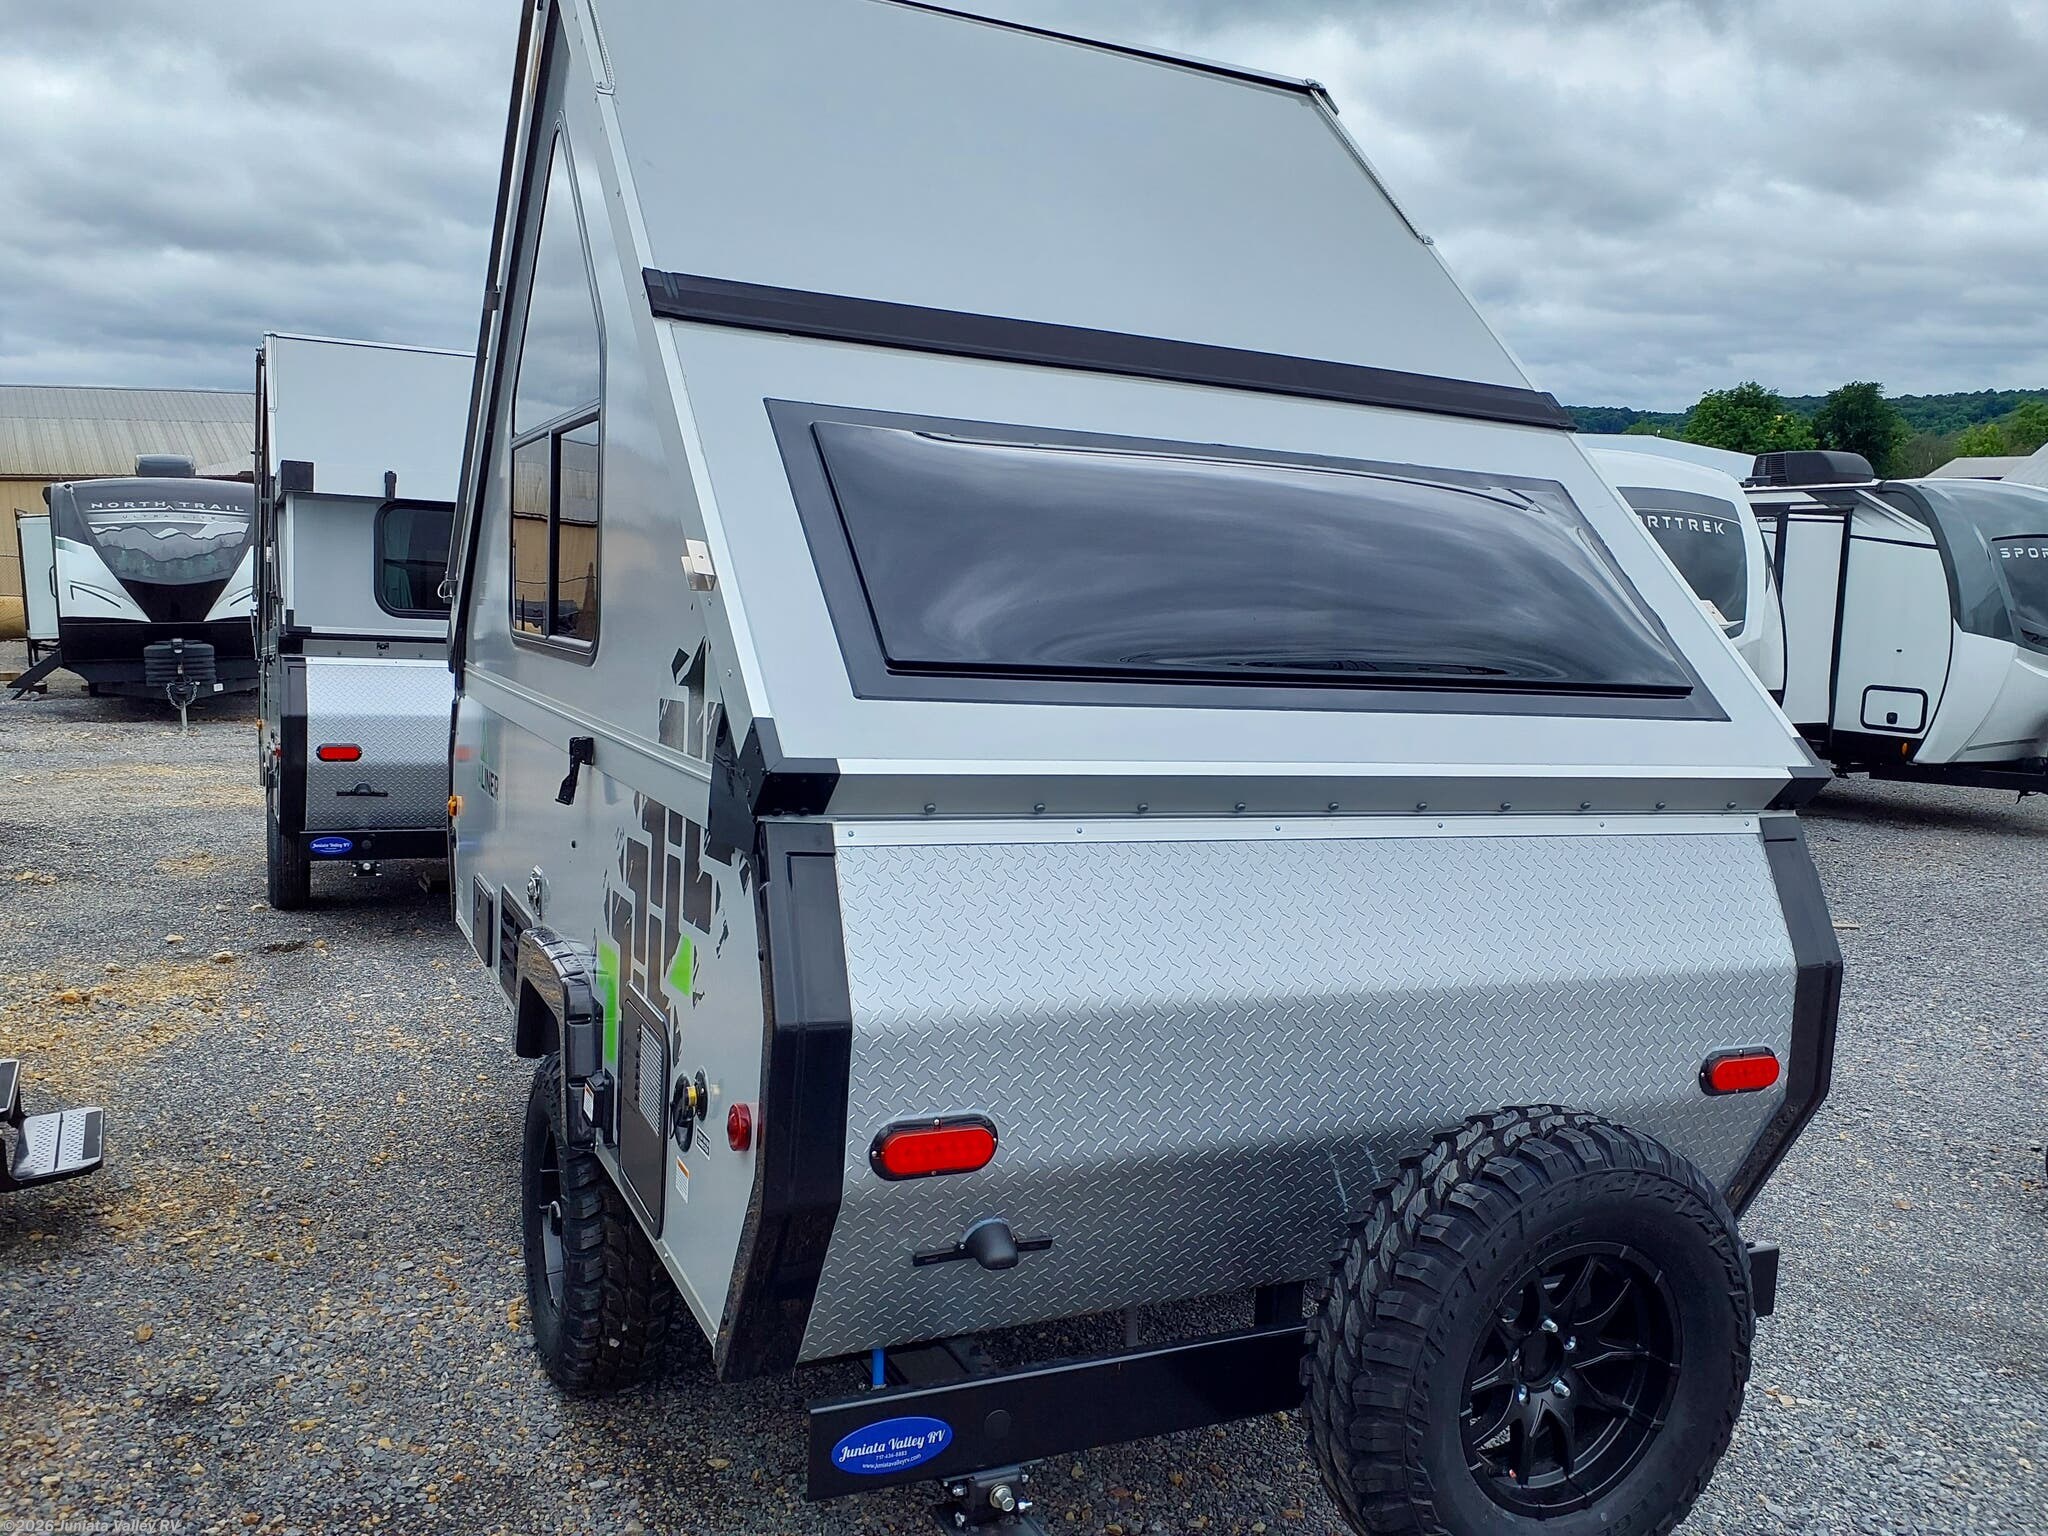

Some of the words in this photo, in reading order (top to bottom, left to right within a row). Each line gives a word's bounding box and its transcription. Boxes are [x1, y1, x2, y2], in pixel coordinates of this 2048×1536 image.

[91, 501, 166, 509] NORTH
[179, 502, 244, 512] TRAIL
[839, 1442, 885, 1463] Juniata
[889, 1436, 925, 1451] Valley
[928, 1429, 946, 1444] RV
